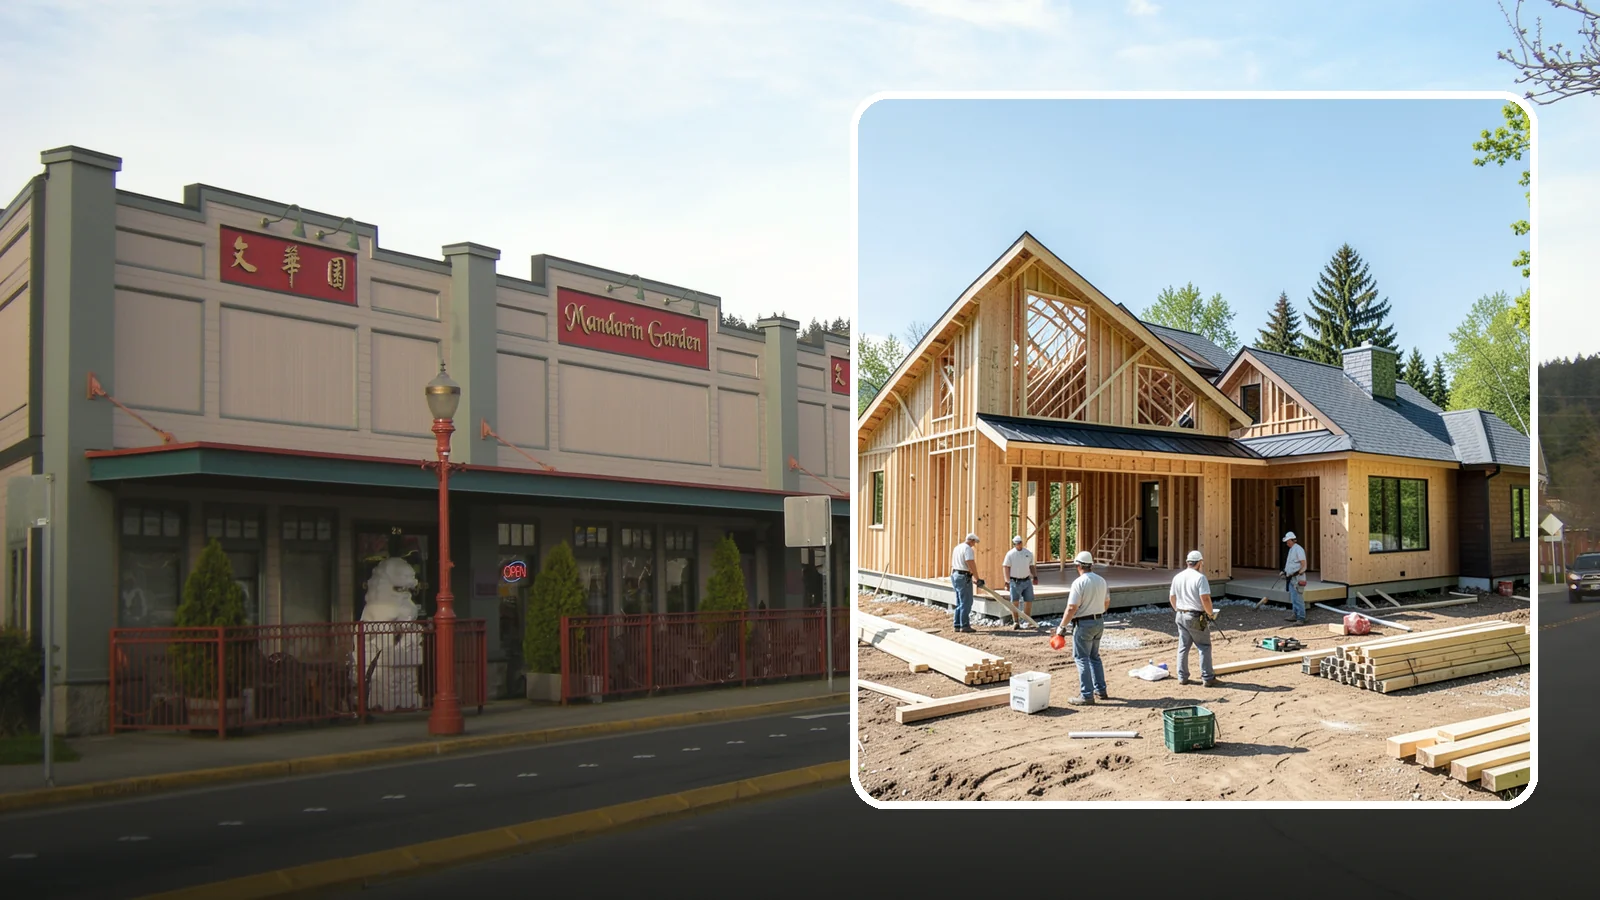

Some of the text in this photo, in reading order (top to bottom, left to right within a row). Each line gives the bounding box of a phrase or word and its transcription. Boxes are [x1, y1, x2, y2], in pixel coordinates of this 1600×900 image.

[231, 235, 346, 291] 文華園
[564, 302, 701, 352] Mandarin Garden
[503, 565, 527, 578] OPEN
